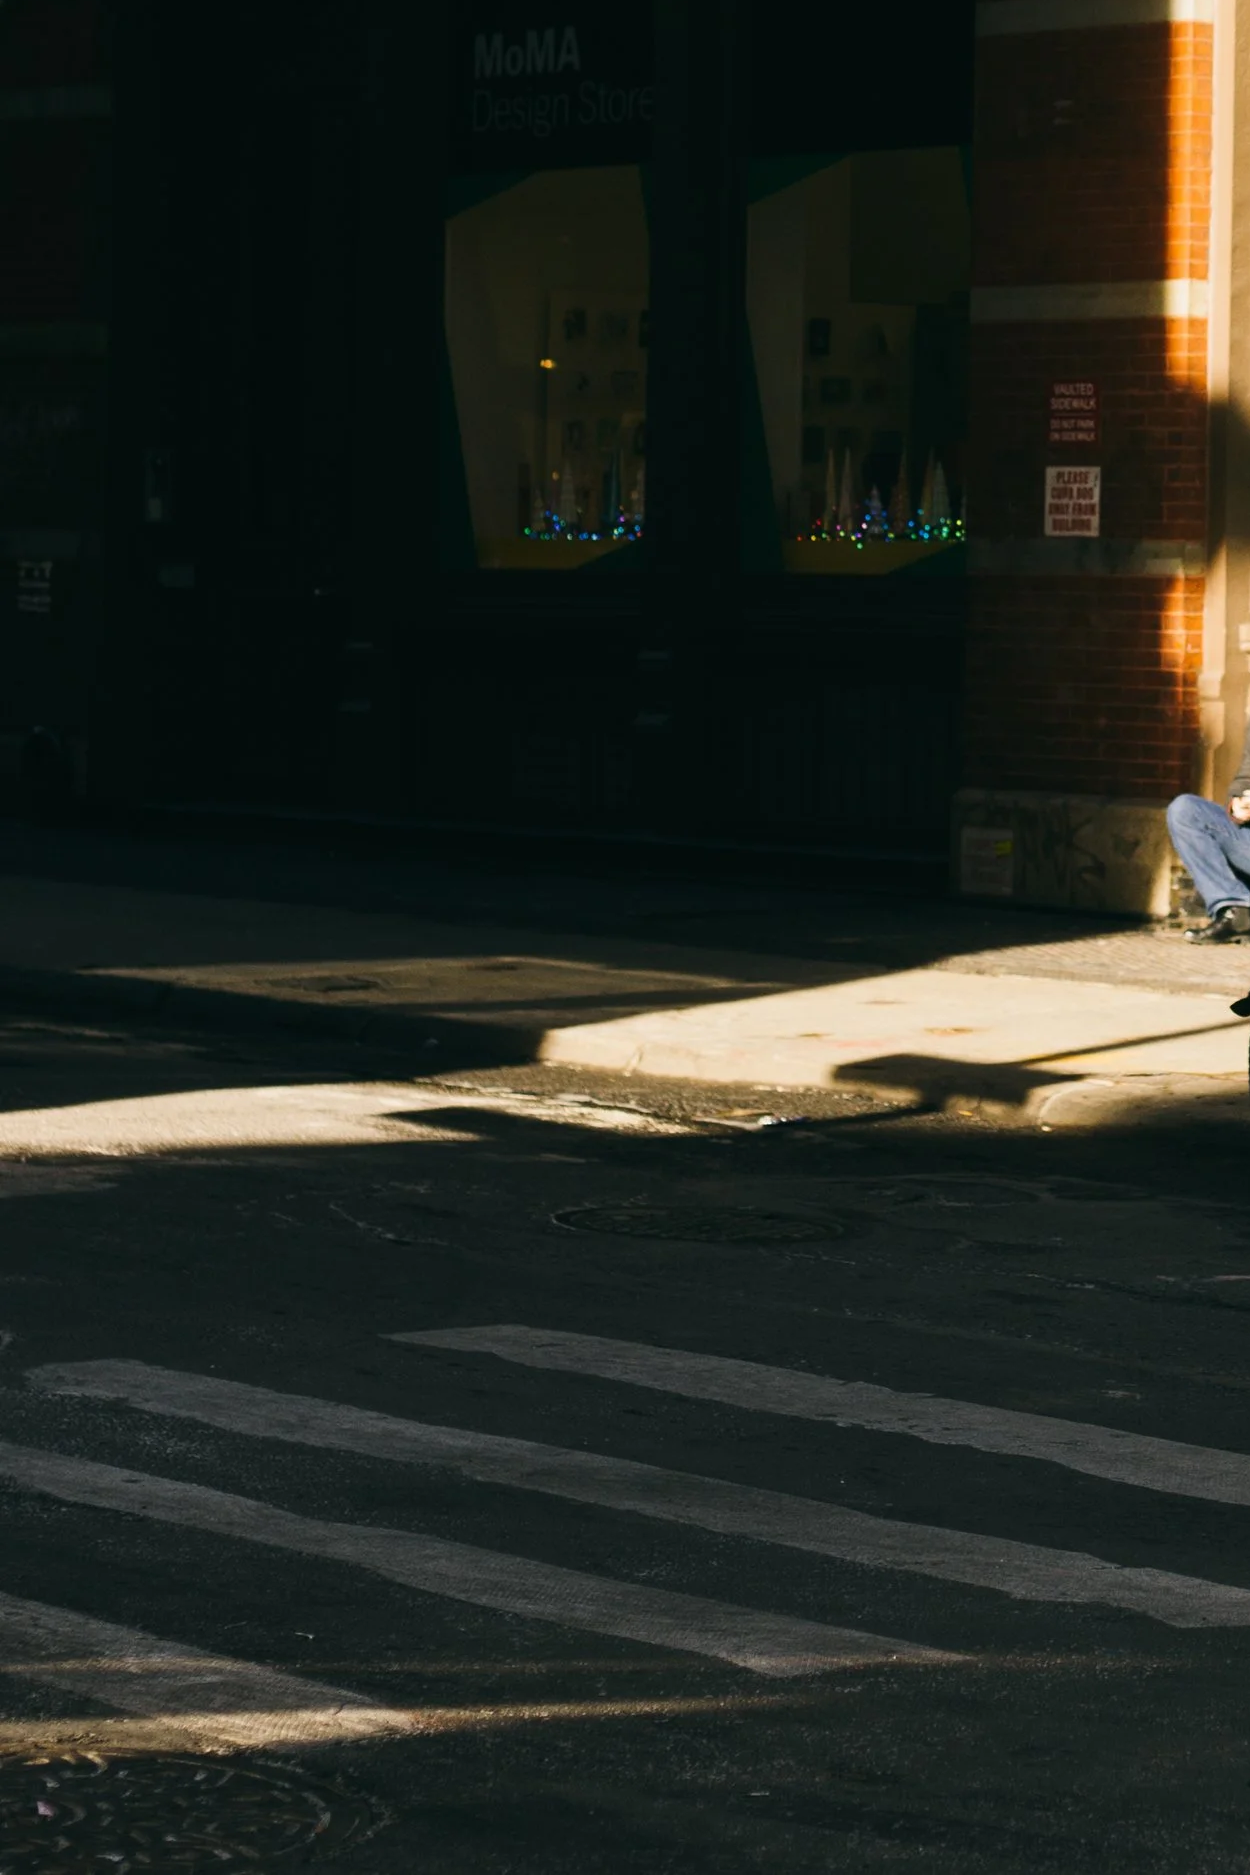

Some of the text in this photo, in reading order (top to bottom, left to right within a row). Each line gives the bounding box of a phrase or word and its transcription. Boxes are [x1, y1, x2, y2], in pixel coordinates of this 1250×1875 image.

[474, 25, 581, 80] MoMA
[472, 80, 654, 138] Design Store
[1053, 382, 1094, 396] VAULTED
[1050, 397, 1097, 410] SIDEWALK
[1056, 471, 1090, 484] PLEASE
